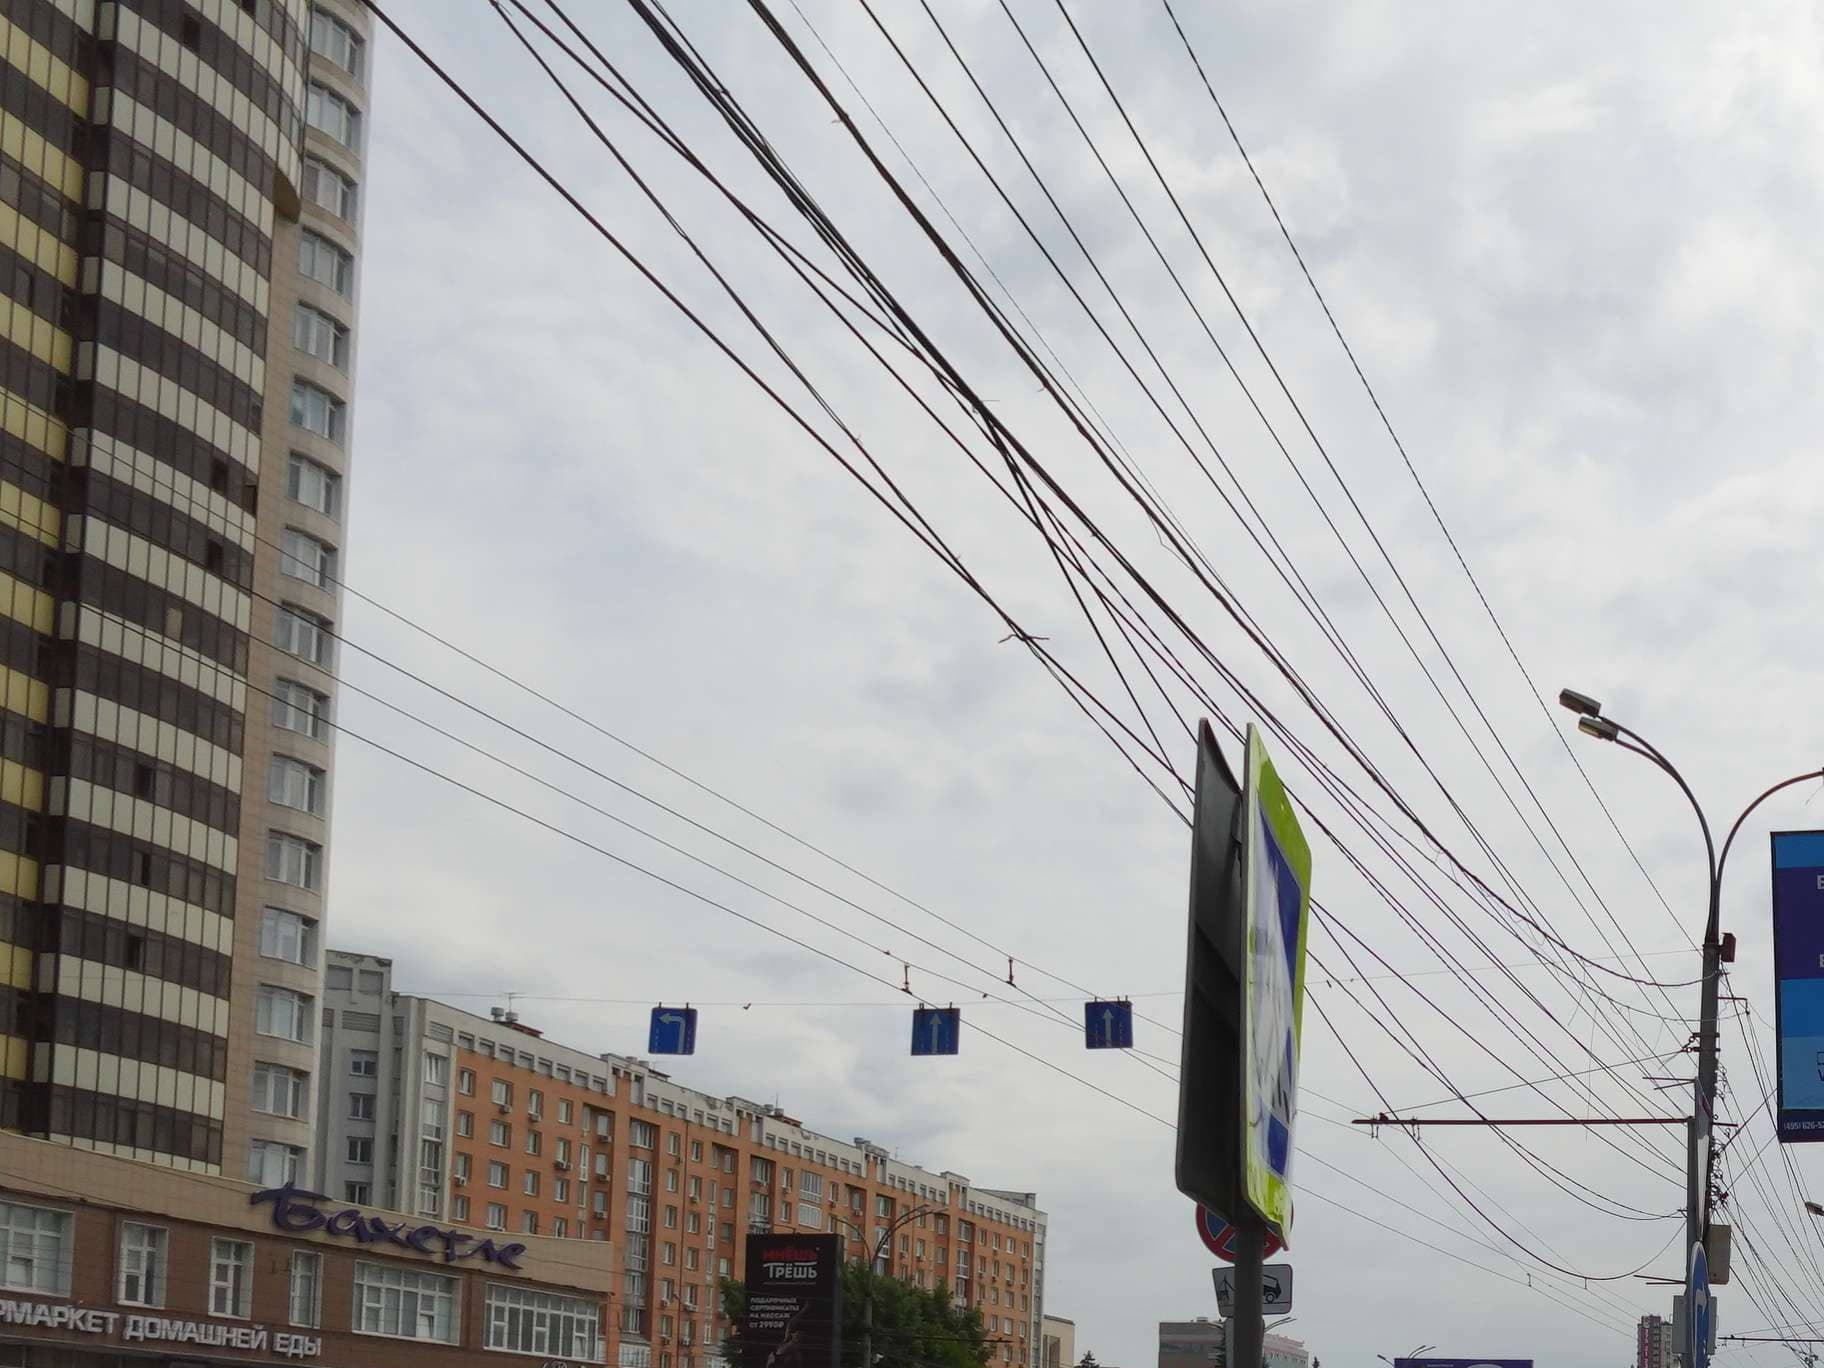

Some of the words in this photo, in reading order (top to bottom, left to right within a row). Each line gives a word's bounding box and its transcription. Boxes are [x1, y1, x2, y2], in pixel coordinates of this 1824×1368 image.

[762, 1261, 818, 1279] ТРЁШЬ
[124, 1314, 268, 1350] ДОМАШНЕЙ
[273, 1332, 322, 1359] ЕДЫ
